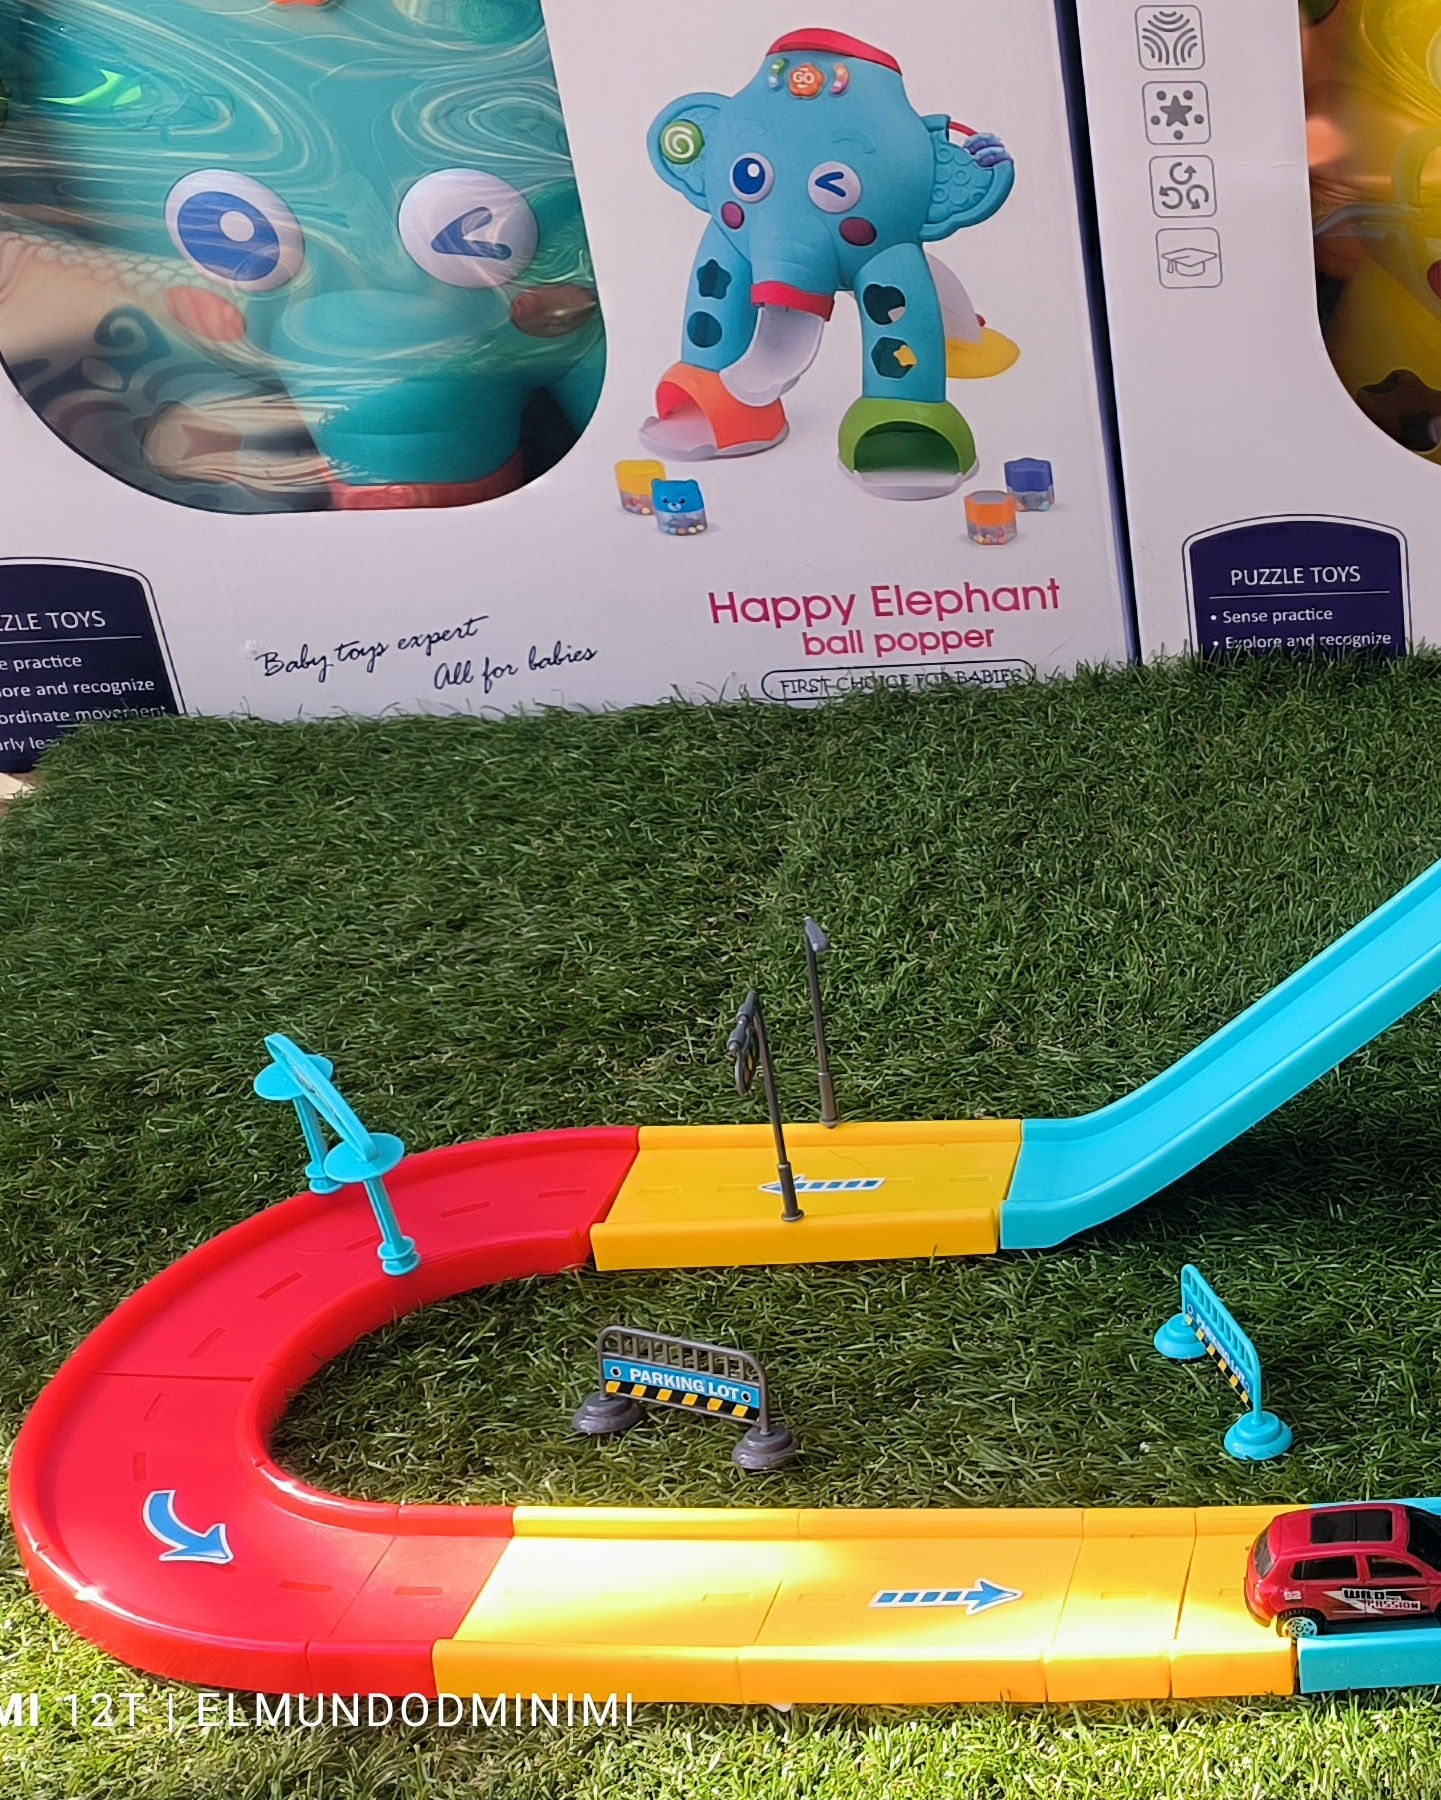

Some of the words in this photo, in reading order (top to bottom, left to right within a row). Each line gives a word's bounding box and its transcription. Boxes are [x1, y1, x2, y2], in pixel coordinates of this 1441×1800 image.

[792, 71, 815, 84] GO
[1230, 567, 1304, 587] PUZZLE
[1312, 565, 1362, 584] TOYS
[707, 590, 856, 629] Happy
[869, 578, 1062, 621] Elephant
[45, 610, 106, 630] TOYS
[1222, 610, 1268, 624] Sense
[1272, 607, 1334, 625] practice
[255, 643, 334, 683] Baby
[334, 640, 390, 673] toys
[397, 615, 490, 656] expert
[801, 629, 864, 657] ball
[874, 627, 995, 658] popper
[1225, 635, 1283, 652] Explore
[1286, 633, 1315, 648] and
[1319, 631, 1392, 649] recognize
[13, 654, 83, 673] practice
[434, 662, 474, 690] All
[481, 656, 519, 694] for
[528, 640, 598, 672] babies
[0, 685, 32, 699] ore
[36, 681, 69, 696] and
[73, 678, 156, 696] recognize
[629, 1367, 705, 1393] PARKING
[708, 1381, 739, 1401] LOT
